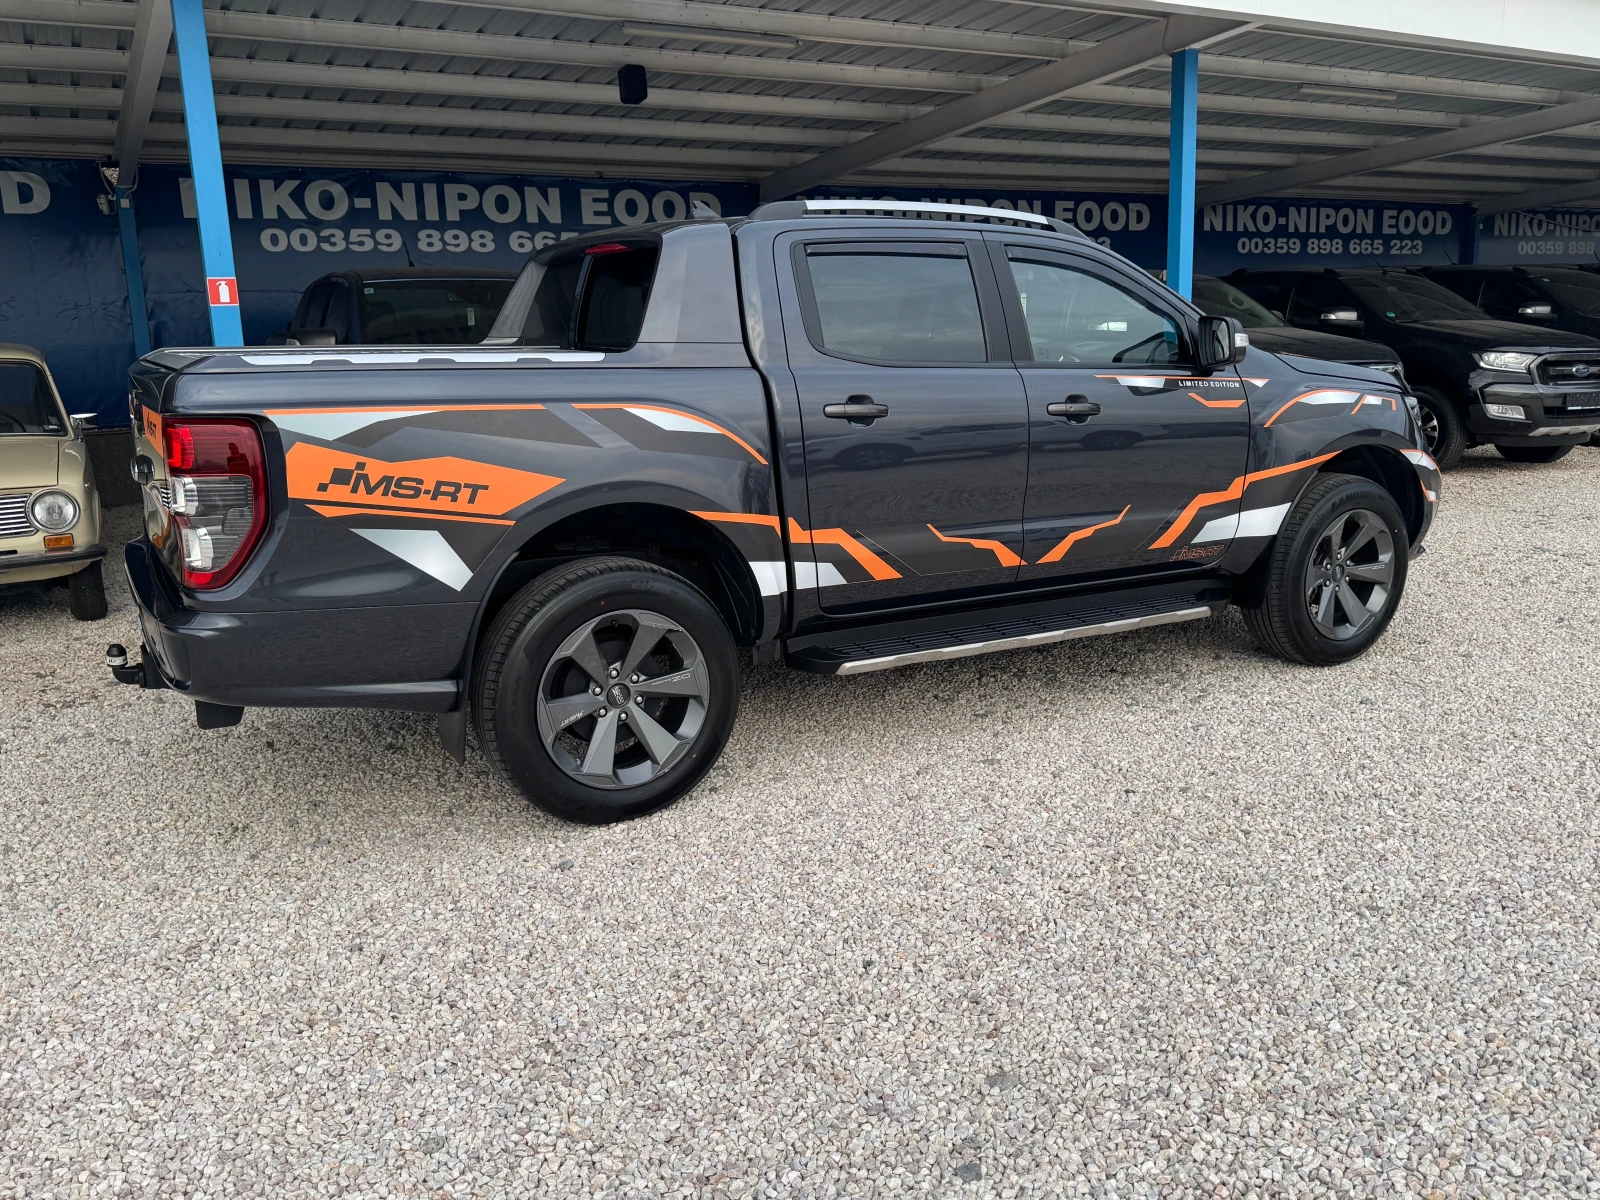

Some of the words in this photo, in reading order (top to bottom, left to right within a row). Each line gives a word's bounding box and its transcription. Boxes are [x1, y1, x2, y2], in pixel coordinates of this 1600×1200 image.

[1055, 198, 1152, 232] EOOD
[1203, 204, 1374, 234] NIKO-NIPON
[1382, 209, 1452, 235] EOOD
[259, 228, 402, 252] 00359
[417, 229, 496, 253] 898
[508, 230, 580, 253] 66
[1237, 237, 1300, 254] 00359
[1307, 238, 1343, 254] 898
[1348, 239, 1384, 255] 665
[1389, 239, 1423, 255] 223
[1517, 241, 1563, 255] 00359
[1568, 241, 1595, 255] 898
[349, 471, 490, 505] MS-RT
